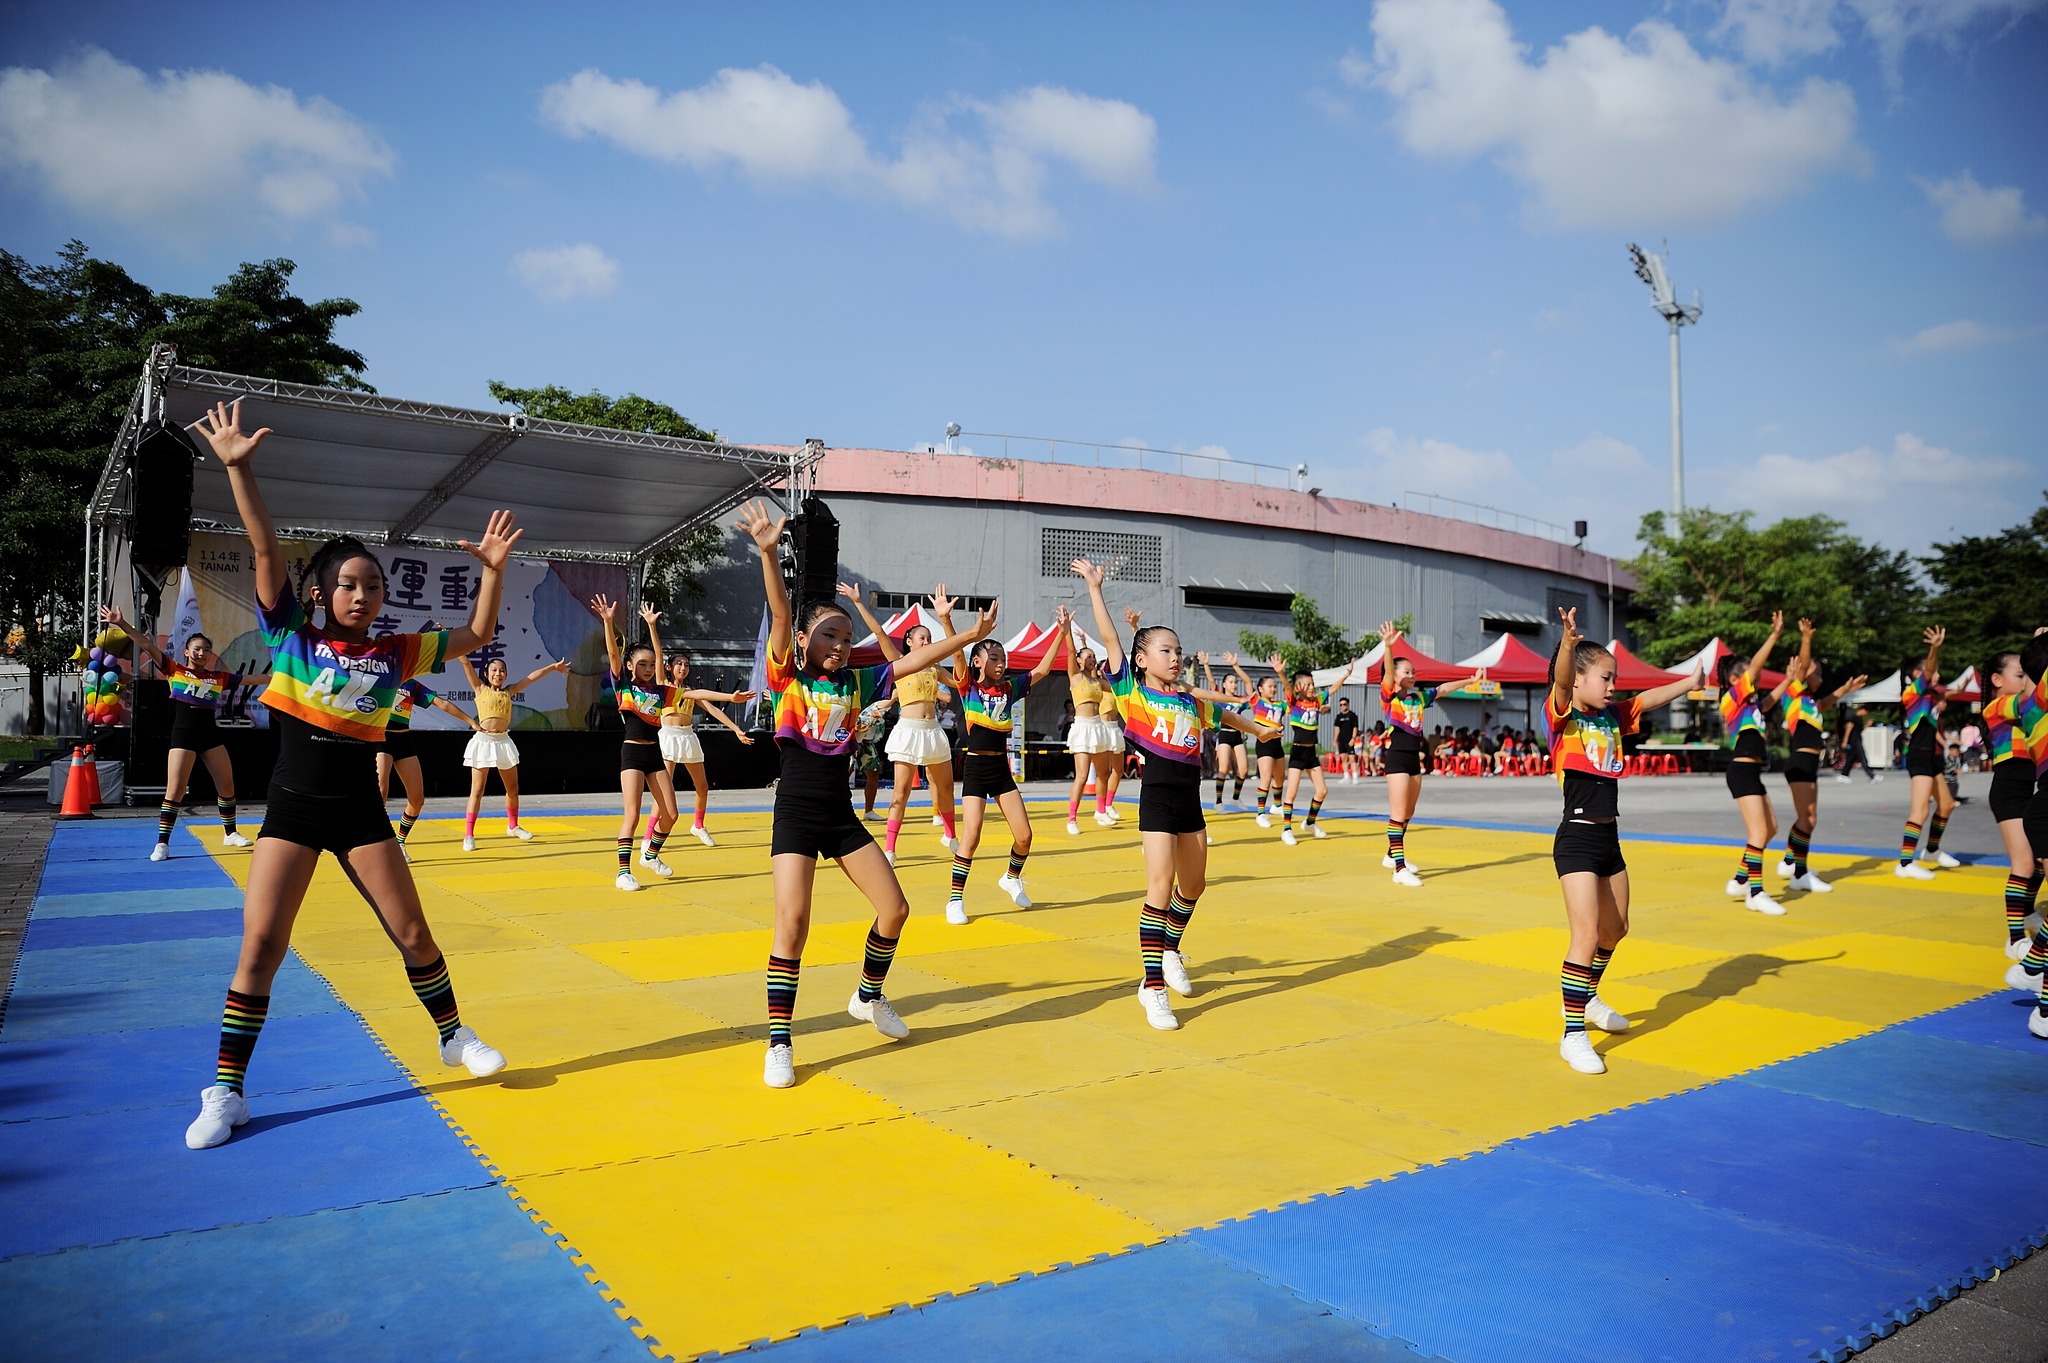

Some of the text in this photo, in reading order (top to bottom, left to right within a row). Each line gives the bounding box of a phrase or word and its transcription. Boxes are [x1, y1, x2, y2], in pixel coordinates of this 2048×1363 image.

[201, 550, 240, 562] 114年
[200, 562, 239, 572] TAINAN
[338, 656, 390, 674] DESIGN
